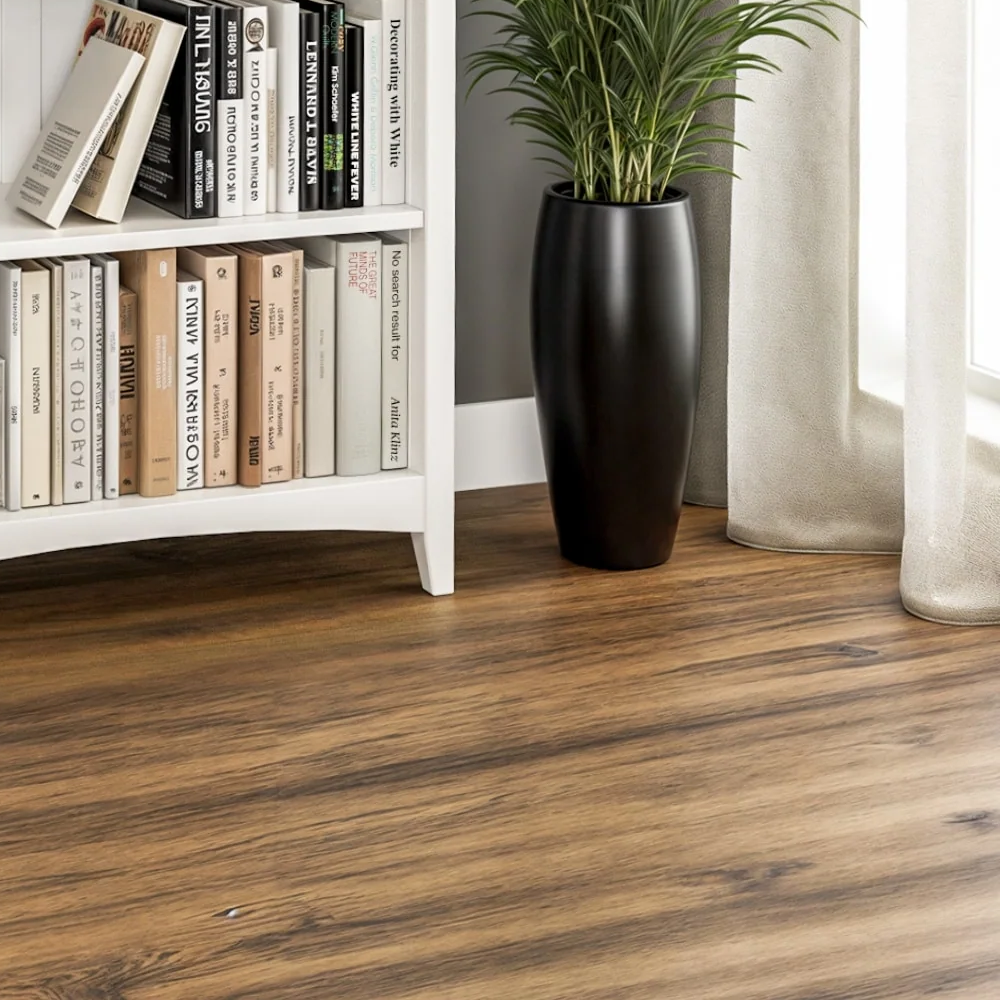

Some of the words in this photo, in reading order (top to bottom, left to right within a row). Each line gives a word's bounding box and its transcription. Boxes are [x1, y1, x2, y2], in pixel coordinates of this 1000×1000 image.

[386, 19, 401, 91] Decorating
[331, 65, 339, 82] Kim
[331, 83, 339, 122] Schaefer
[350, 91, 360, 131] WHITE
[389, 95, 401, 123] with
[350, 132, 360, 160] LINE
[389, 127, 401, 168] White
[350, 161, 360, 201] FEVER
[348, 251, 358, 288] FUTURE
[359, 250, 368, 280] MINDS
[368, 250, 377, 268] THE
[392, 250, 402, 267] No
[359, 281, 368, 294] OF
[368, 269, 377, 300] GREAT
[392, 269, 402, 308] search
[391, 310, 401, 342] result
[391, 344, 401, 361] for
[390, 396, 401, 428] Anita
[390, 432, 402, 462] Klinz
